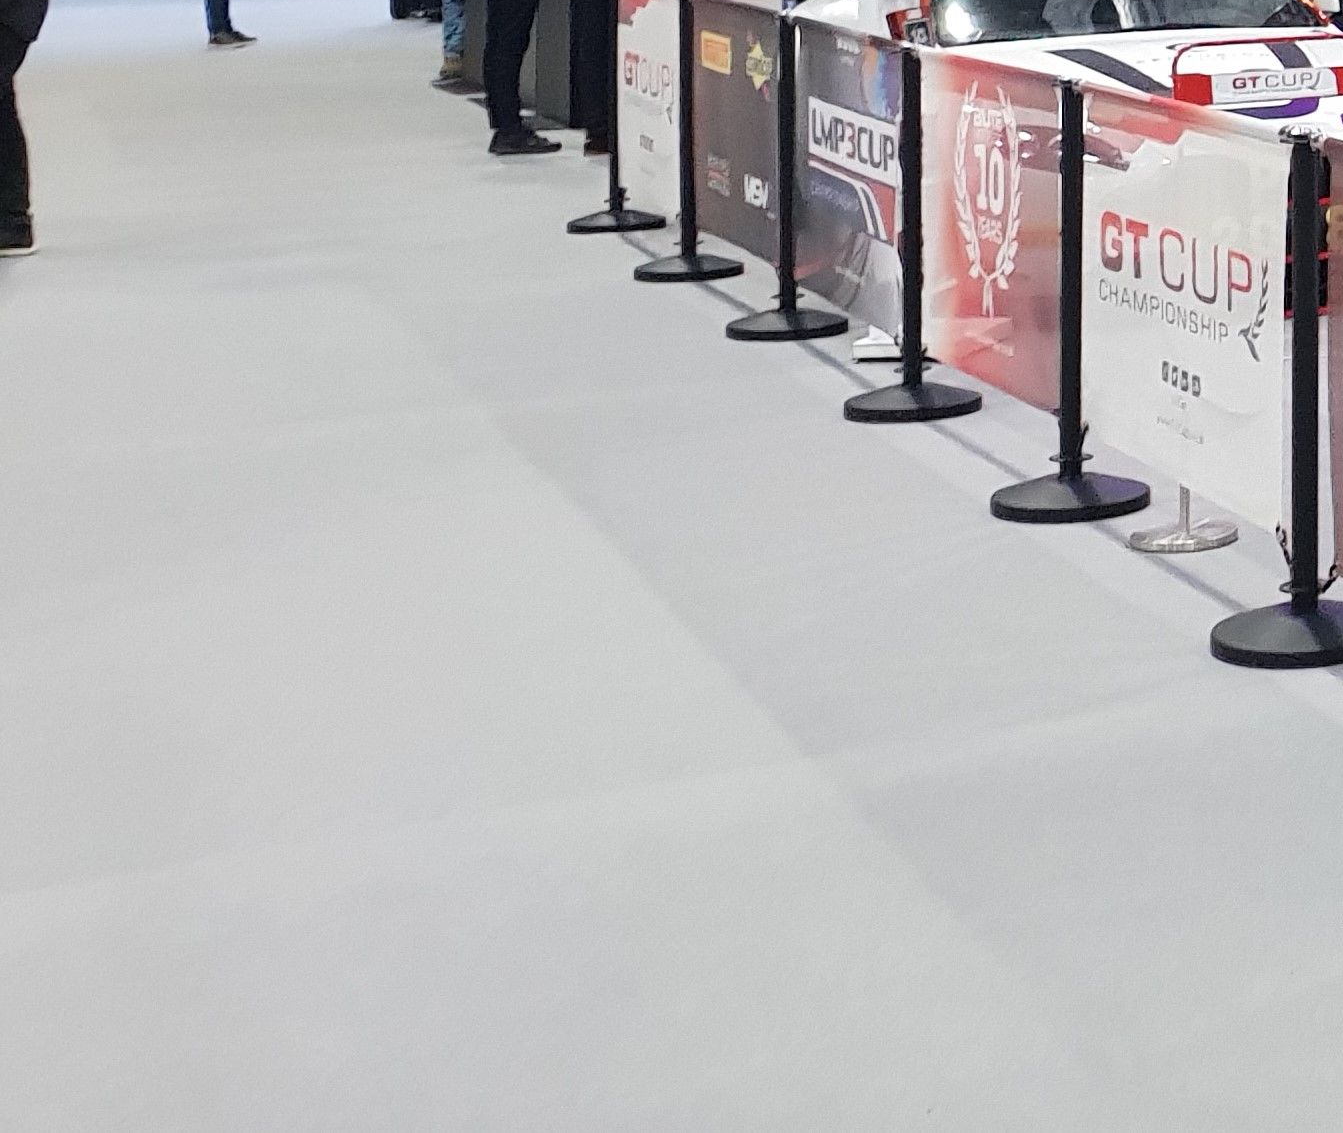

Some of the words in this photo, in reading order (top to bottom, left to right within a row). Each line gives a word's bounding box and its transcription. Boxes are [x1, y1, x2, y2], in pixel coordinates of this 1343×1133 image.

[1232, 76, 1261, 89] GT
[1265, 72, 1314, 89] CUP
[811, 107, 895, 173] LMP3CUP
[973, 143, 1006, 216] 10
[1101, 210, 1149, 279] GT
[1159, 227, 1253, 313] CUP
[1099, 278, 1229, 343] CHAMPIONSHIP
